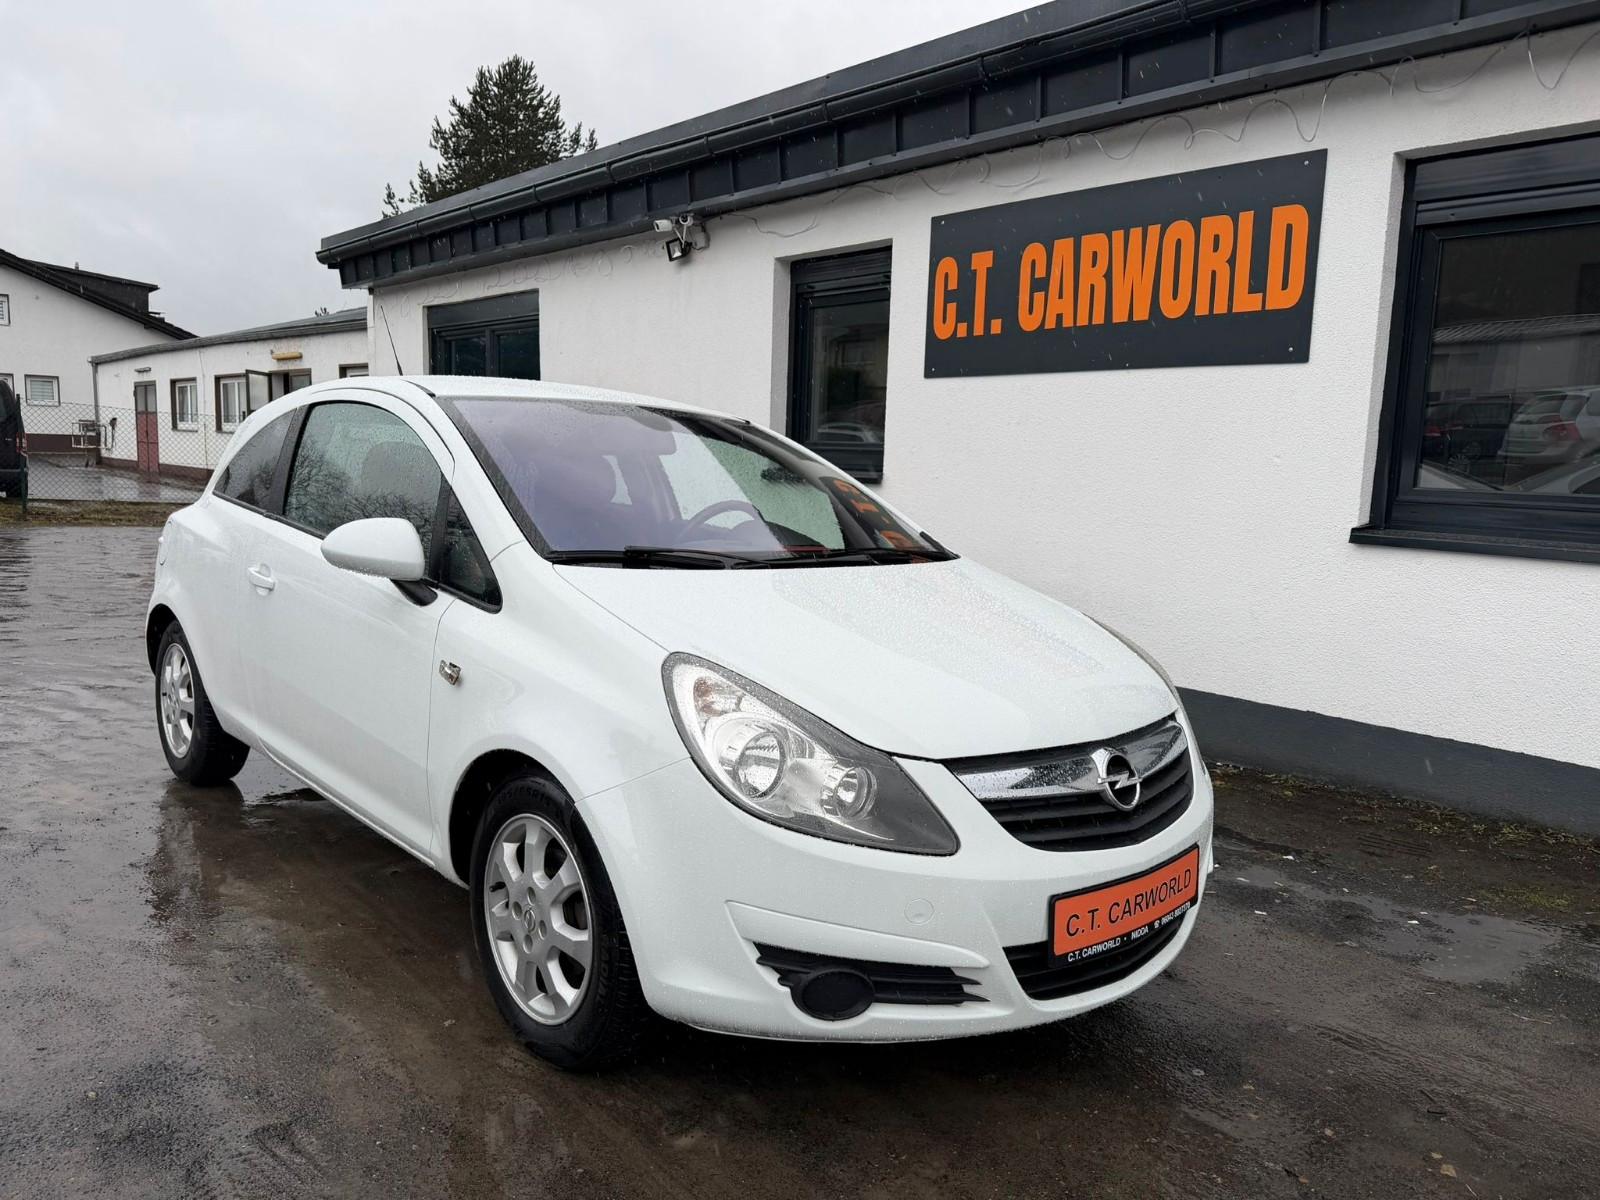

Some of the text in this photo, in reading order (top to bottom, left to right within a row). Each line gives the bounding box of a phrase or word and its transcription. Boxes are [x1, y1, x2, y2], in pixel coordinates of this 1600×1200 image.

[933, 203, 1309, 340] C.T. CARWORLD
[1066, 907, 1100, 937] C.T.
[1108, 868, 1192, 924] CARWORLD
[1067, 925, 1149, 962] C.T. CARWORLD NIDDA
